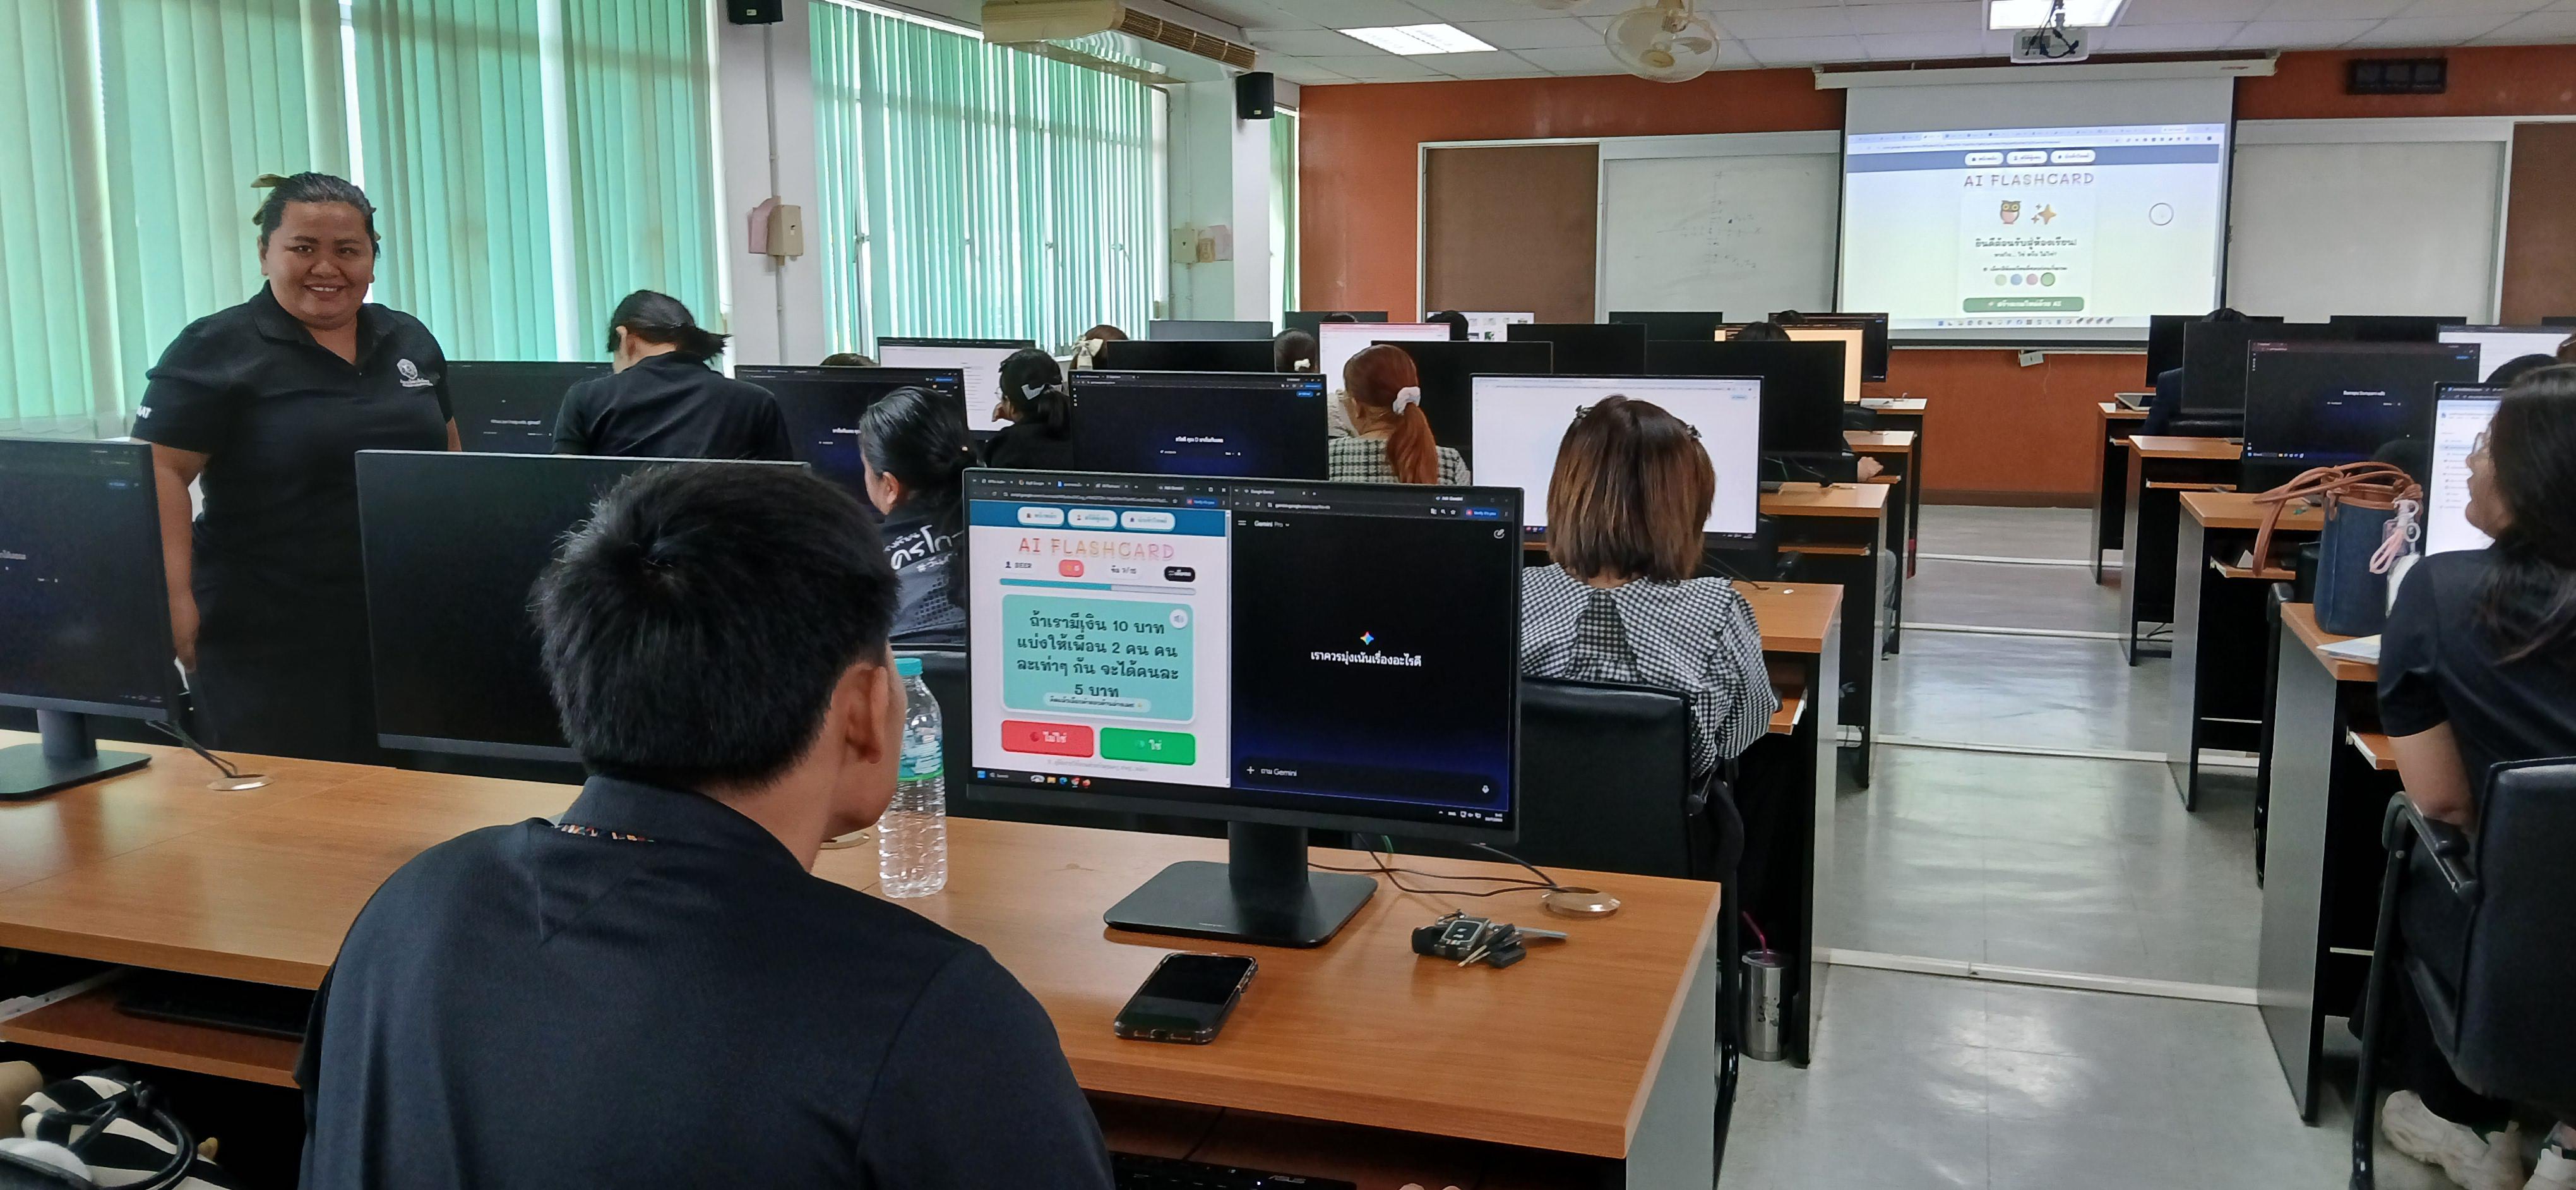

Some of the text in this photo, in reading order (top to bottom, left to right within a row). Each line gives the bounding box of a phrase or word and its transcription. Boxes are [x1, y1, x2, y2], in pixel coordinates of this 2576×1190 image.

[1964, 172, 2094, 186] AI FLASHCARD
[1018, 538, 1174, 560] AI FLASHCARD
[1030, 610, 1164, 634] ถ้าเรามีเงิน 10 บาท
[1017, 630, 1178, 658] แบ่งให้เพื่อน 2 คน คน
[1311, 650, 1422, 666] เราควรมุ่งเน้นเรื่องอะไรดี
[1017, 656, 1179, 680] ละเท่าๆ กัน จะได้คนละ
[1075, 684, 1119, 697] 5 บาท
[1273, 768, 1297, 776] Gemini
